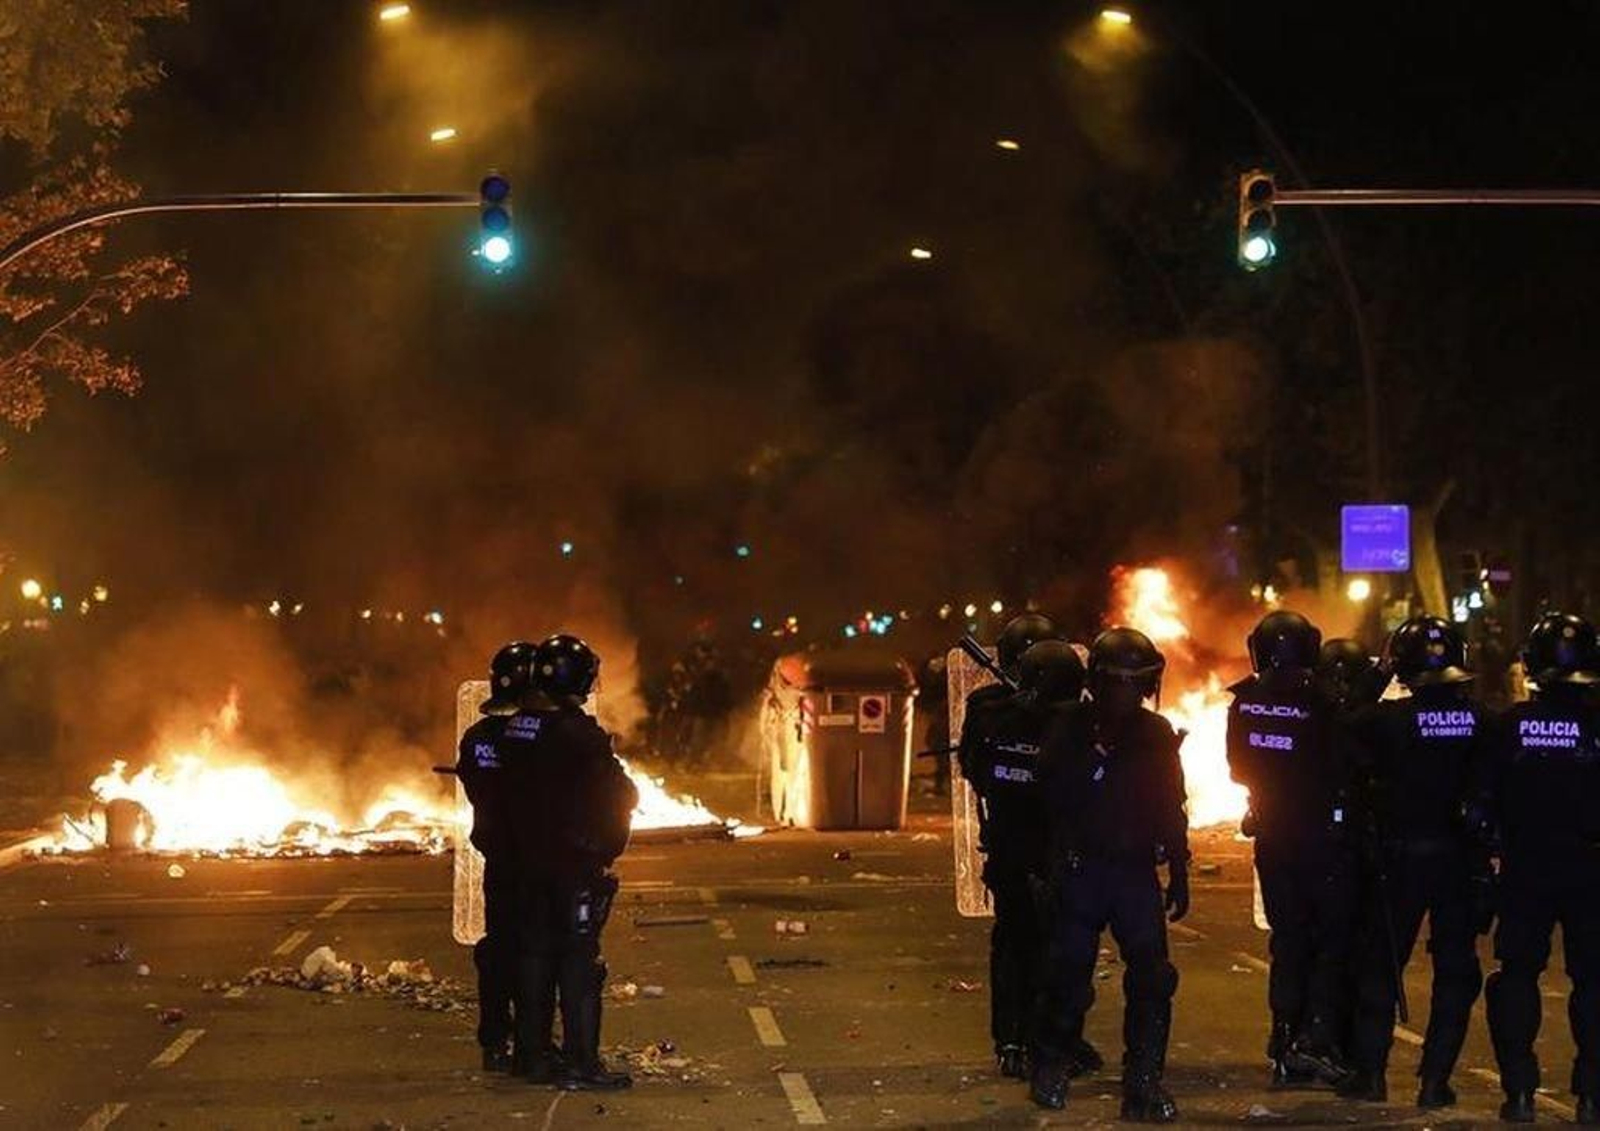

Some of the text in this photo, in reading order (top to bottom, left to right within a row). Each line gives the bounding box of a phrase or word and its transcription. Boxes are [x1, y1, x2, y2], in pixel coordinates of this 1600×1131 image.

[1239, 702, 1300, 719] POLICIA
[1417, 710, 1476, 727] POLICIA
[1519, 720, 1580, 738] POLICIA
